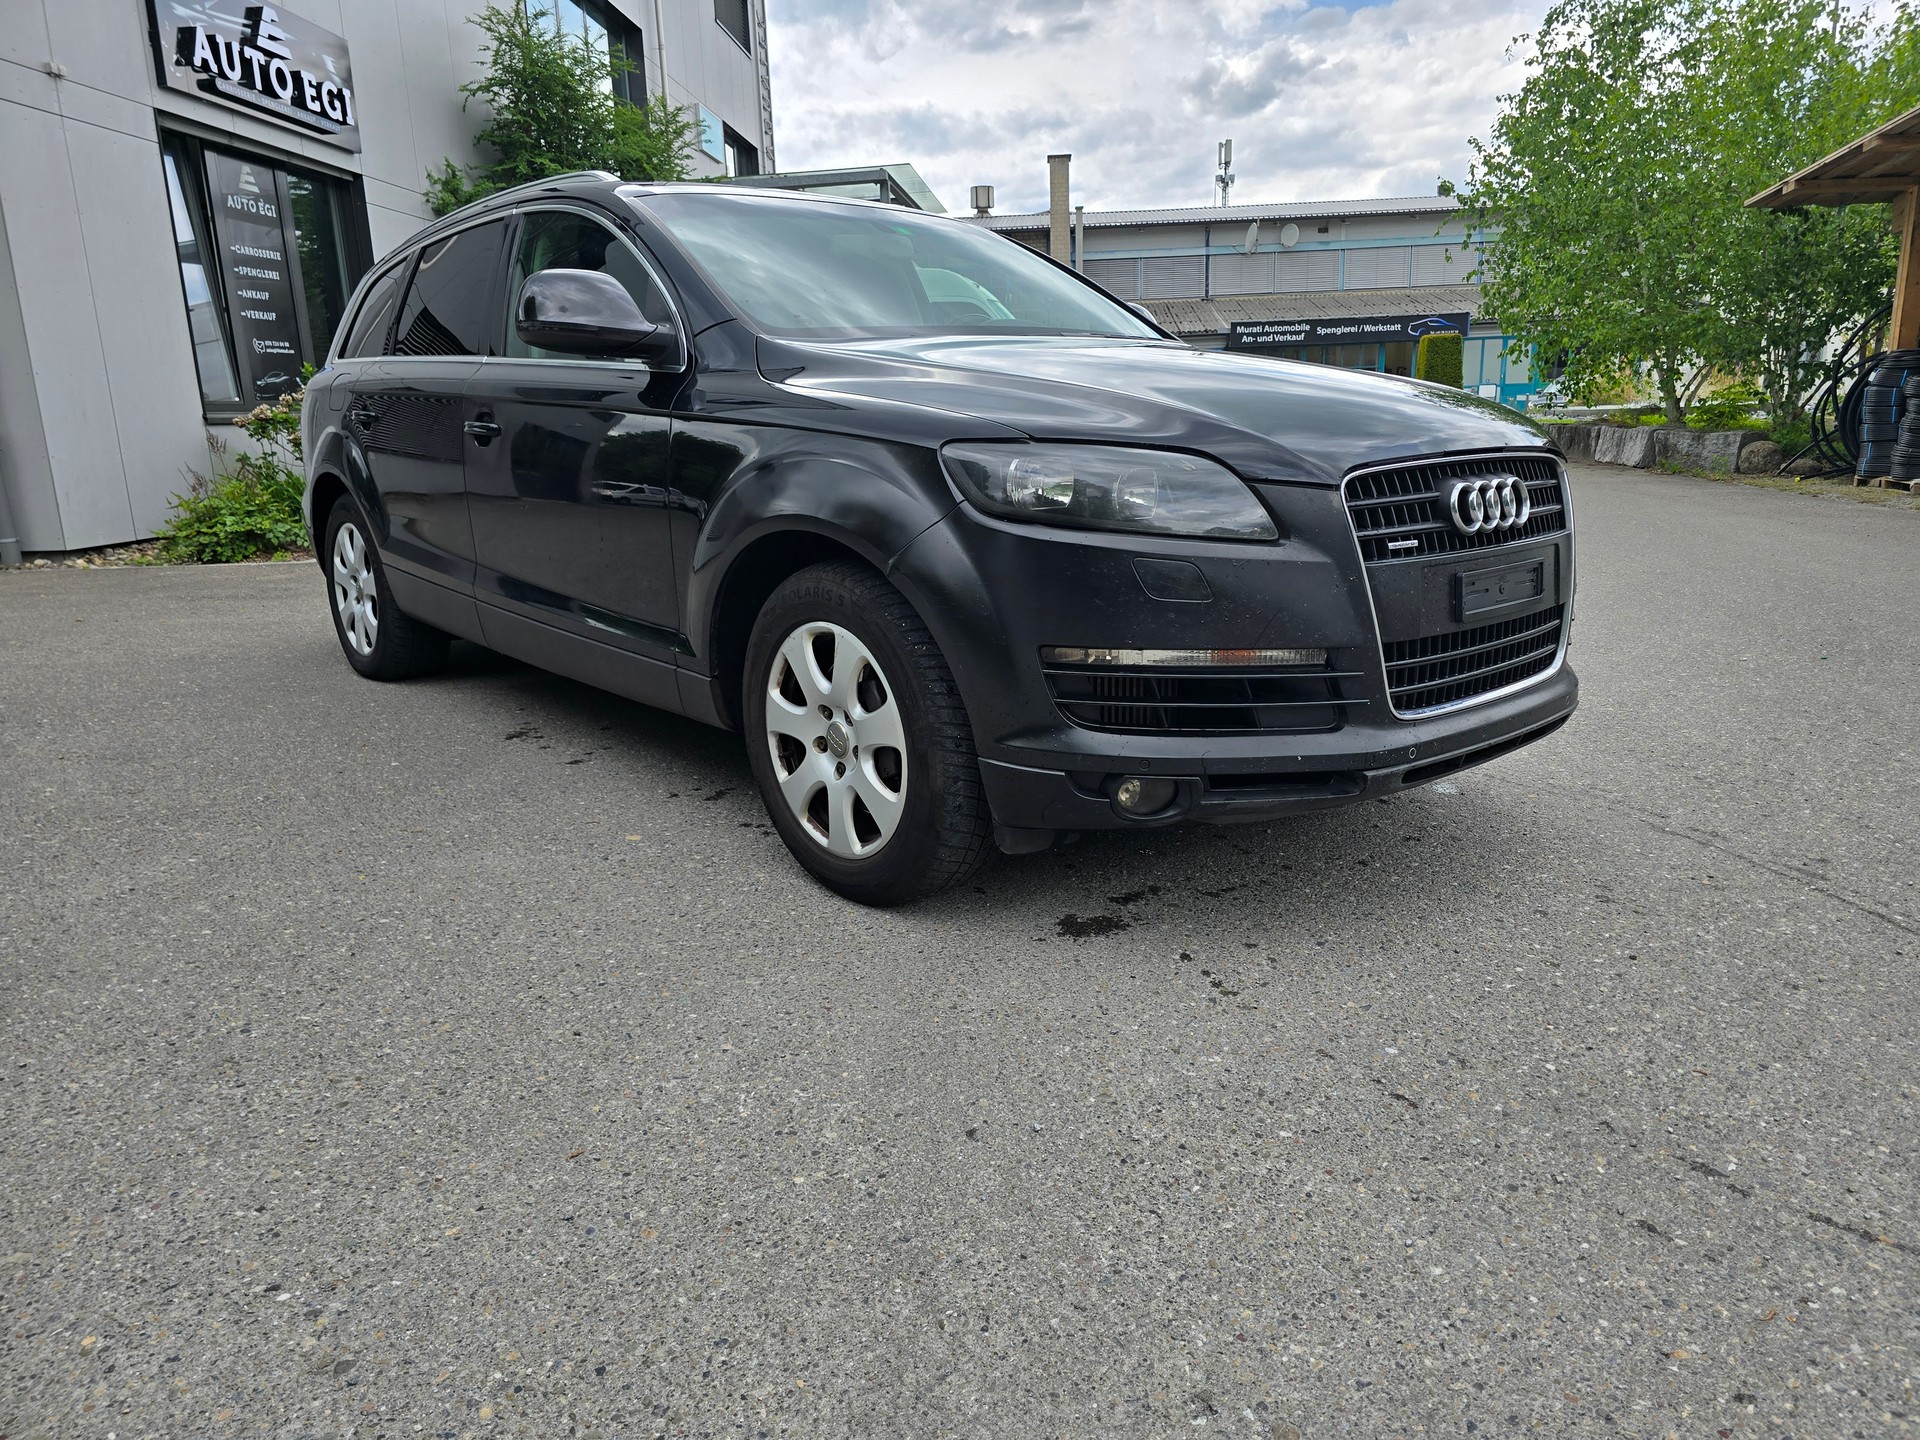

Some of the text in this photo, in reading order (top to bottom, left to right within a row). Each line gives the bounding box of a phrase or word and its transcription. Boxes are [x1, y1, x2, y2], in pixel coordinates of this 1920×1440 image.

[194, 25, 354, 126] AUTO EGI
[227, 194, 257, 213] AUTO
[1236, 323, 1311, 334] Murati Automobile
[1316, 325, 1358, 336] Spenglerei
[1363, 323, 1402, 332] Werkstatt
[1241, 332, 1305, 343] An- und Verkauf
